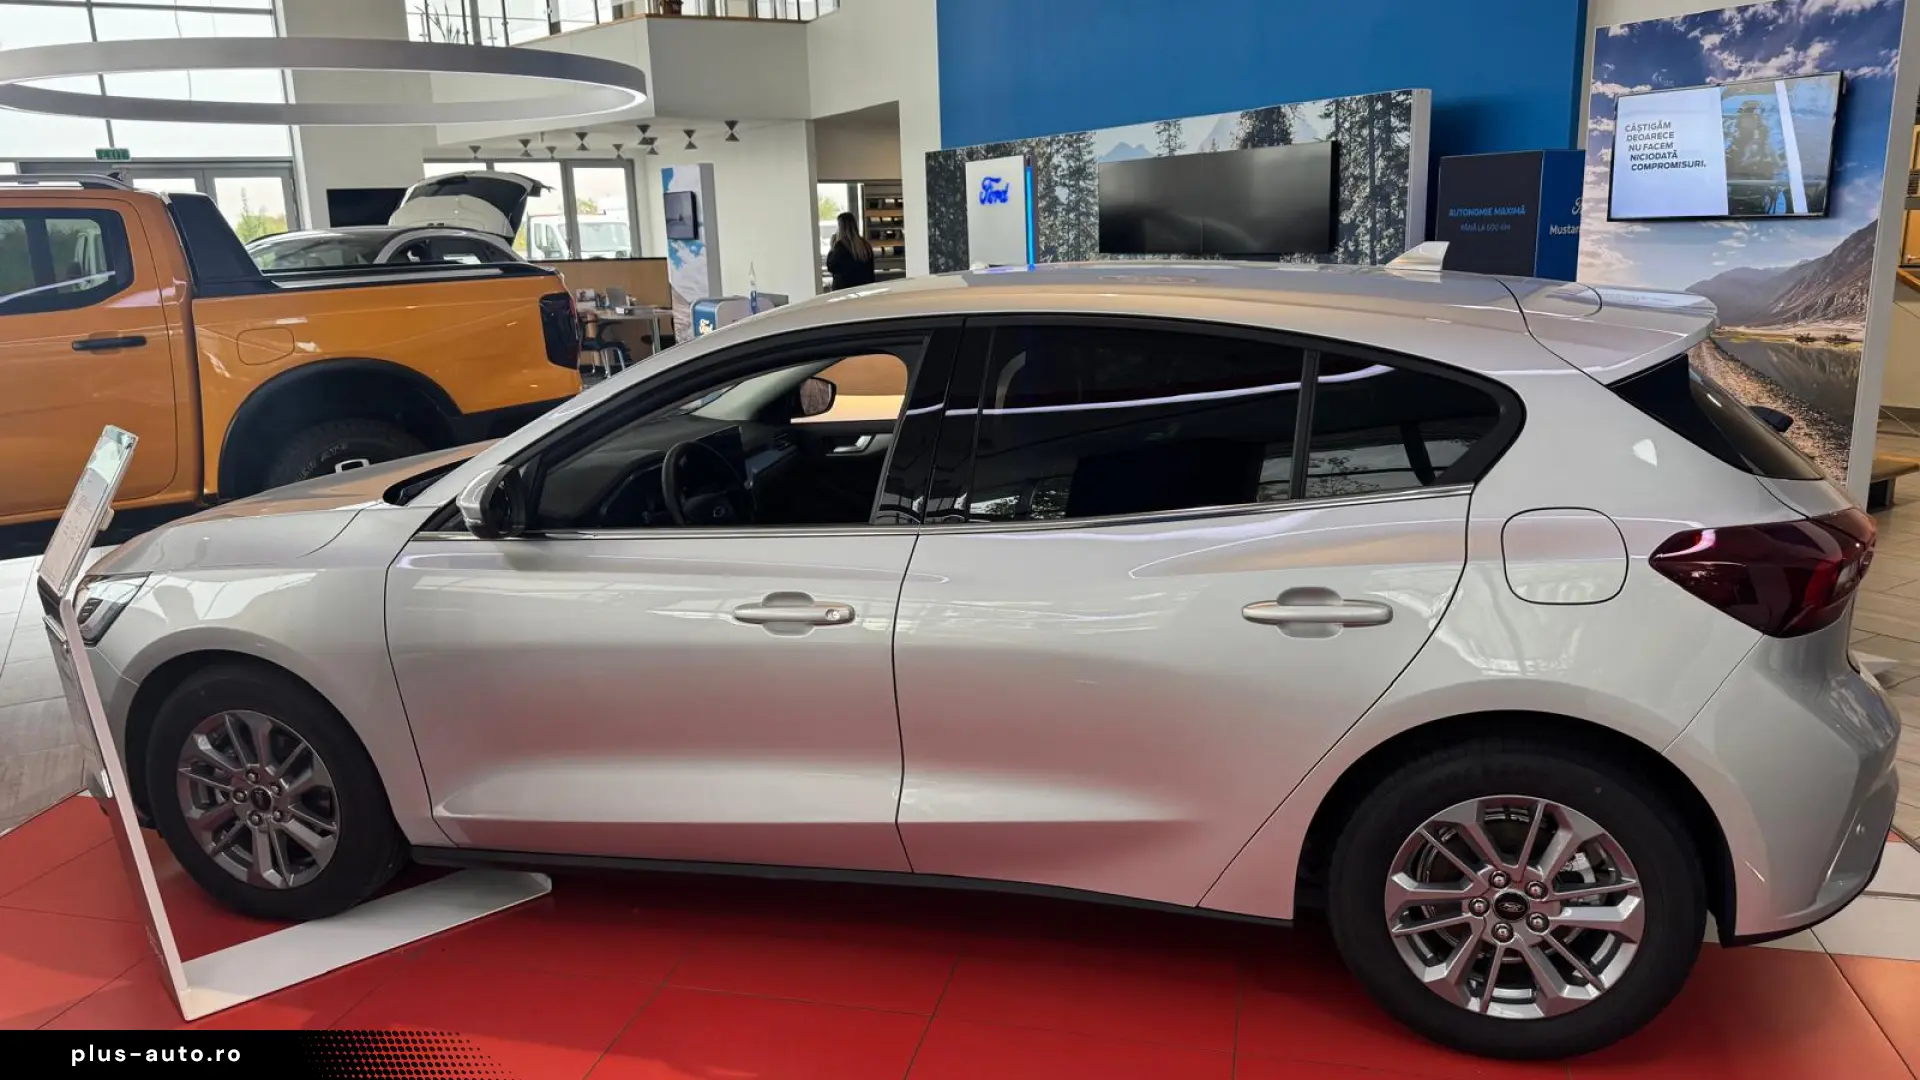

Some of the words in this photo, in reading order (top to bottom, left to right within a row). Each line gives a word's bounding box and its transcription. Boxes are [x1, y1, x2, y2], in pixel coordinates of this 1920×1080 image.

[1626, 131, 1674, 142] DEOARECE
[1629, 143, 1642, 152] NU
[1643, 142, 1674, 151] FACEM
[1630, 149, 1678, 162] NICIODATĂ
[1631, 160, 1706, 171] COMPROMISURI.
[979, 176, 1010, 206] Ford
[1449, 207, 1493, 217] AUTONOMIE
[1494, 204, 1526, 215] MAXIMĂ
